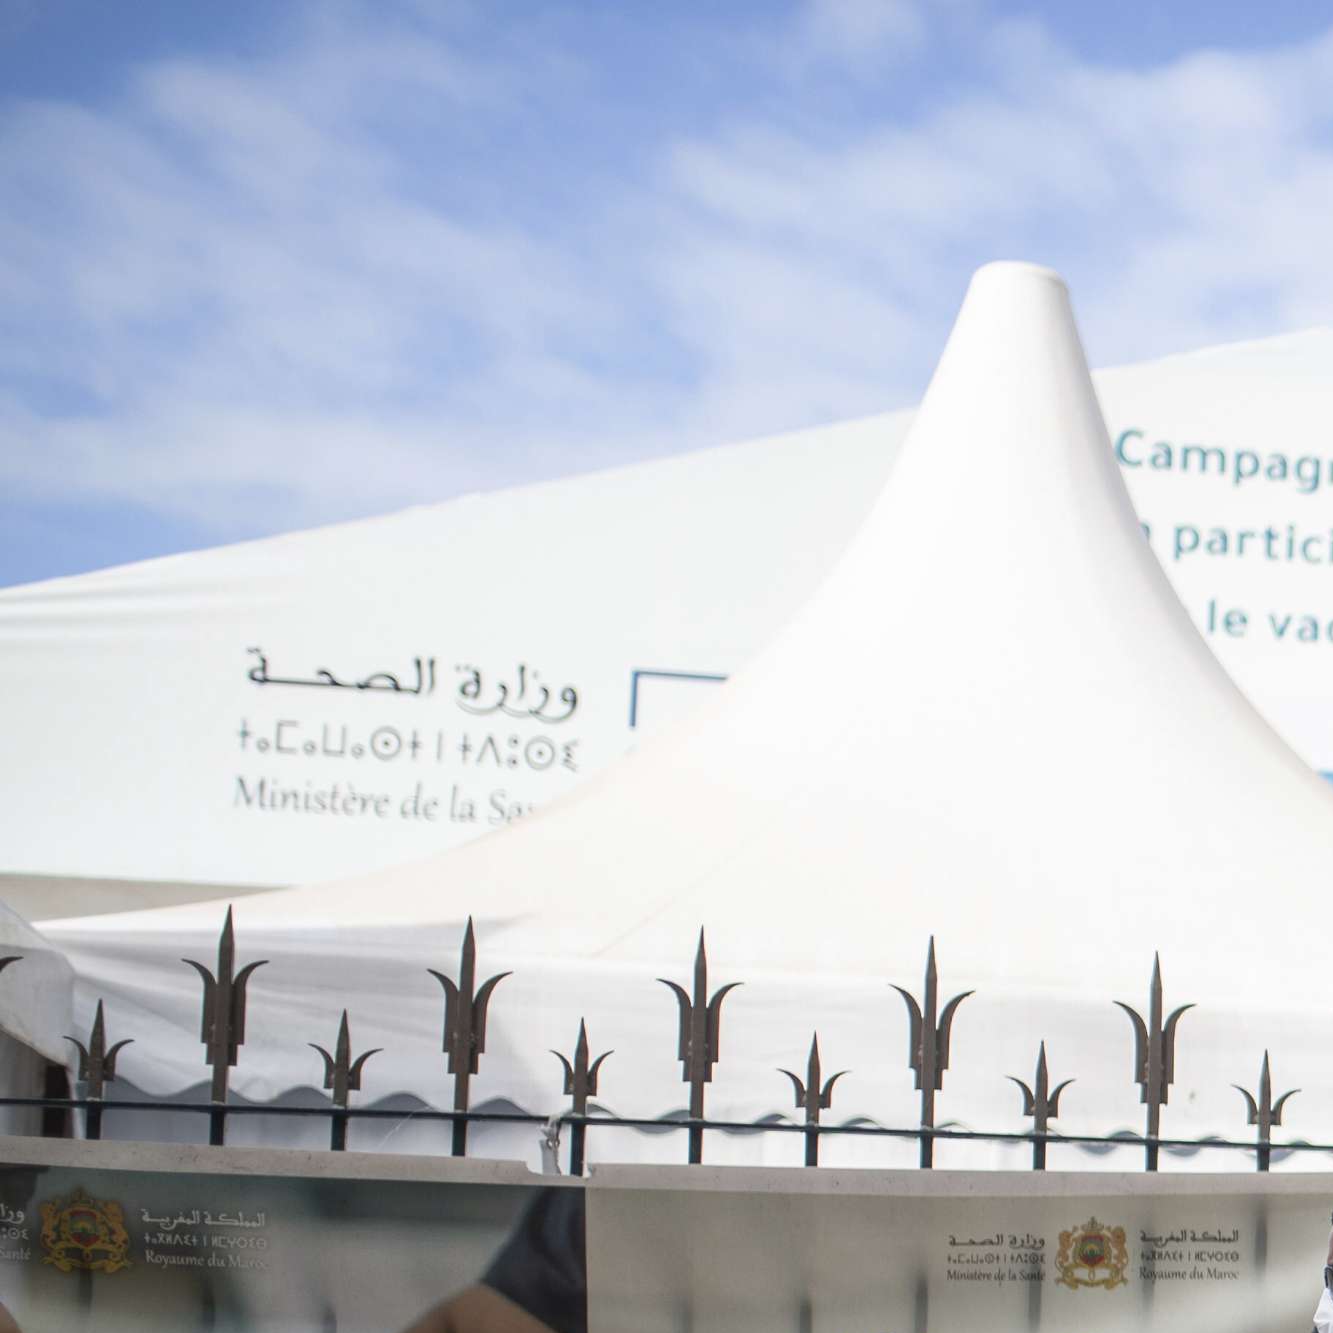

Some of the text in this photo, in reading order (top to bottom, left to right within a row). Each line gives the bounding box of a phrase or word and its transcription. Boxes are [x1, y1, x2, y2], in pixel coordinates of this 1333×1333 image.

[1206, 599, 1249, 639] le
[244, 645, 579, 722] وزارة الصحة
[233, 774, 392, 820] Ministère
[399, 779, 439, 822] de
[449, 781, 477, 823] la
[141, 1207, 266, 1231] المملكة المغربية
[948, 1232, 1046, 1251] وزارة الصحة
[144, 1248, 205, 1270] Royaume
[946, 1266, 993, 1281] Ministère
